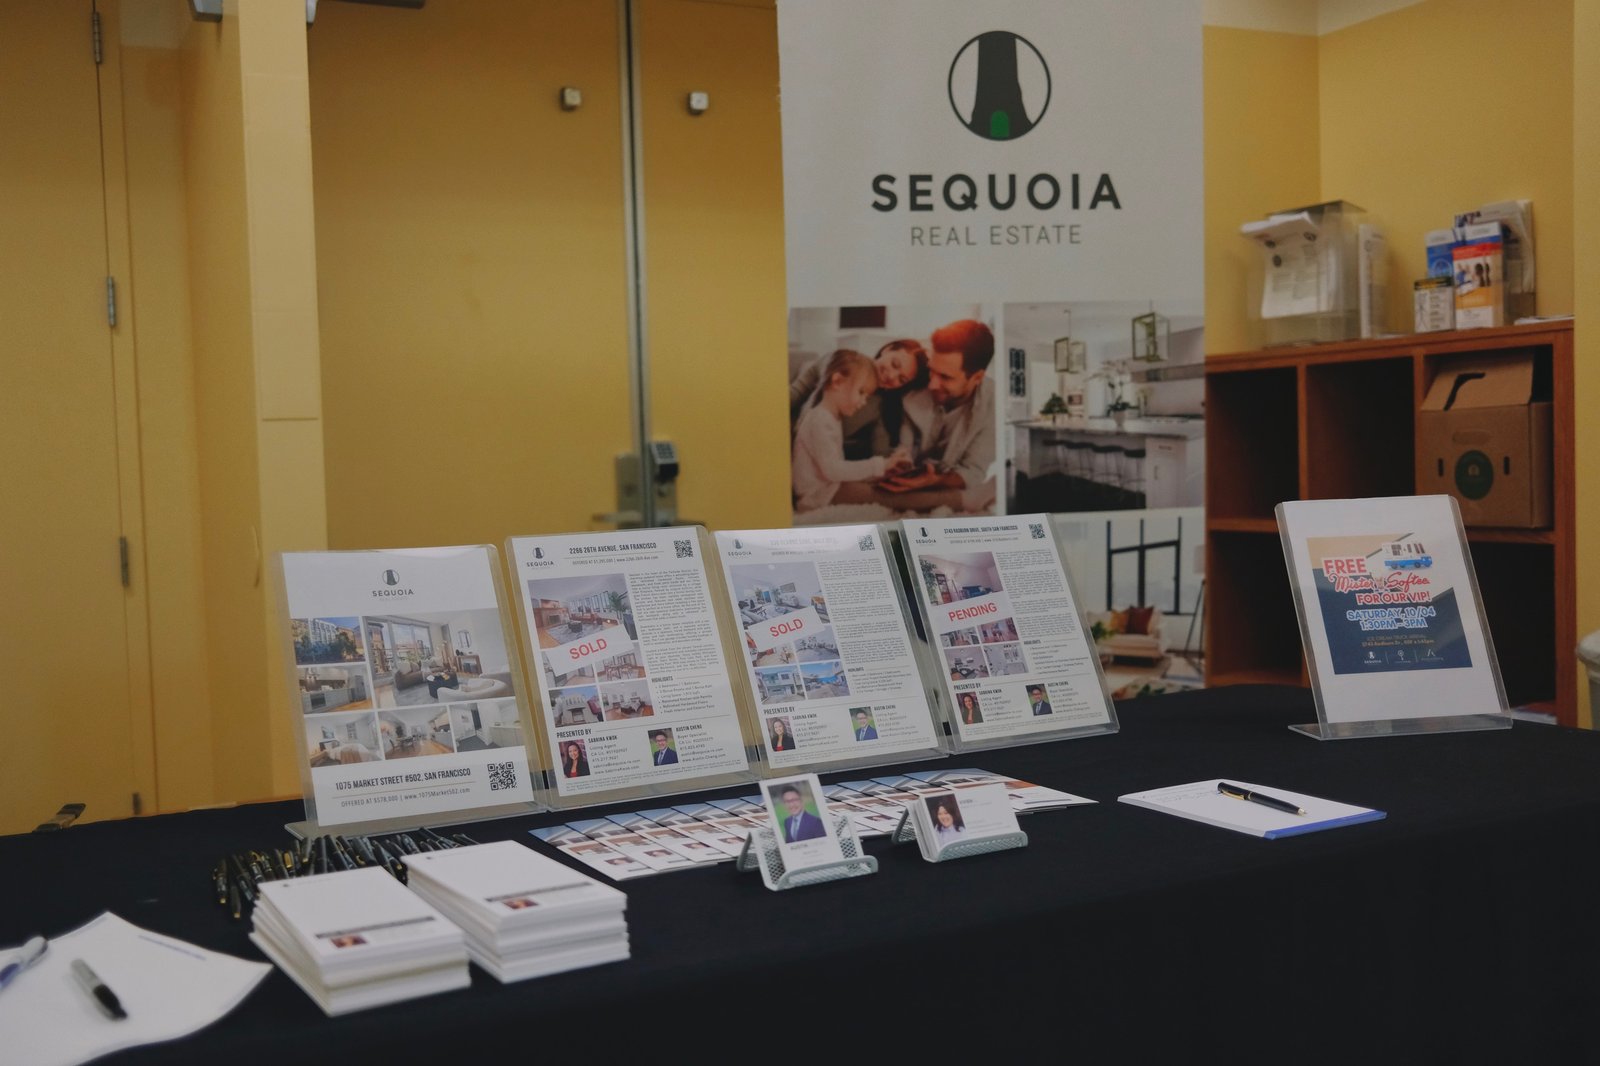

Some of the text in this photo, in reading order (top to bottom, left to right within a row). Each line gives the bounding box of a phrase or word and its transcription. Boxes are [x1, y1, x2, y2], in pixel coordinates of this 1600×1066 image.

[871, 173, 1122, 212] SEQUOIA
[910, 225, 1082, 246] REAL ESTATE
[630, 542, 657, 550] FRANCISCO
[1323, 558, 1367, 575] FREE
[1328, 572, 1430, 593] Mister Softee
[372, 588, 414, 597] SEQUOIA
[1357, 591, 1430, 605] FOR OUR VIP!
[948, 601, 998, 622] PENDING
[1347, 606, 1436, 620] SATURDAY, 10/04
[769, 617, 804, 638] SOLD
[1360, 619, 1397, 630] 1:30PM
[1404, 618, 1428, 628] 3PM
[569, 637, 608, 660] SOLD
[953, 682, 976, 690] PRESENTED
[763, 706, 789, 715] PRESENTED
[556, 729, 584, 739] PRESENTED
[336, 767, 472, 790] 1075 MARKET STREET #502, SAN FRANCISCO
[341, 798, 366, 808] OFFERED
[366, 797, 373, 805] AT
